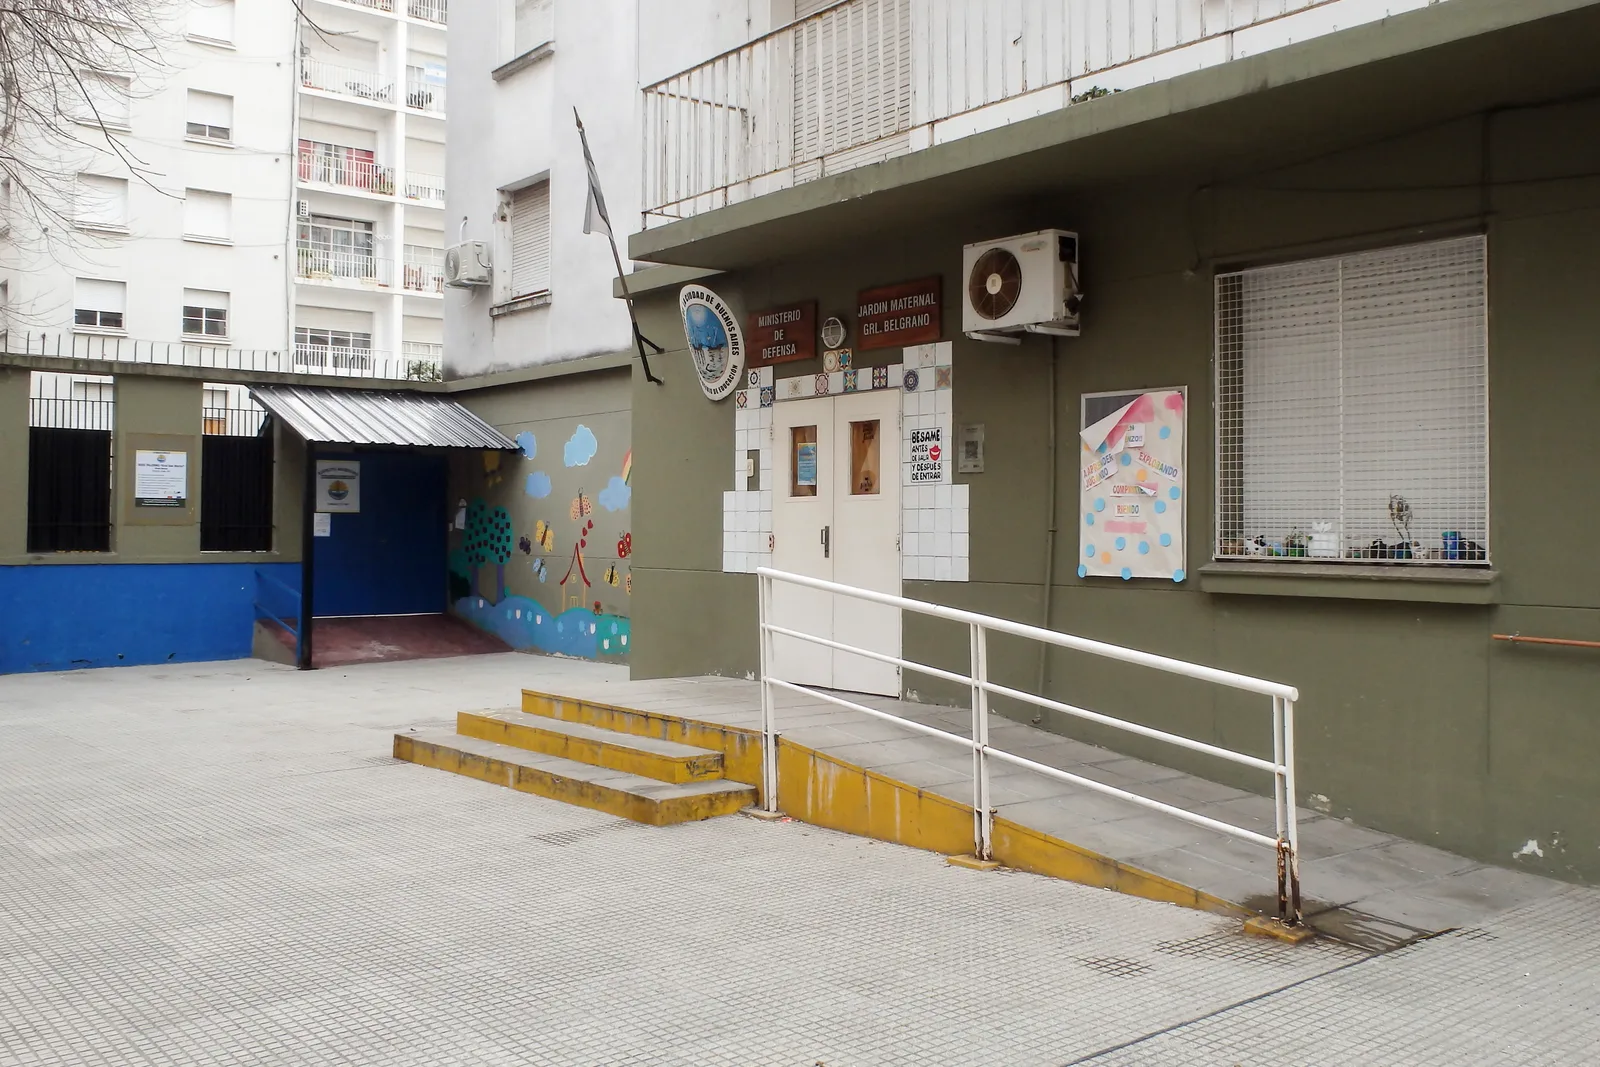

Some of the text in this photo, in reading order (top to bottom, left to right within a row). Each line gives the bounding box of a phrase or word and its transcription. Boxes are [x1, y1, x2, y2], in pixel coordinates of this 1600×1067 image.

[857, 293, 936, 318] JARDIN MATERNAL
[684, 290, 705, 302] CIUDAD
[705, 293, 715, 305] DE
[714, 302, 736, 333] BUENOS
[729, 333, 740, 356] AIRES
[758, 309, 801, 328] MINISTERIO
[863, 313, 930, 336] GRL. BELGRANO
[774, 329, 784, 341] DE
[762, 343, 796, 360] DEFENSA
[911, 444, 928, 453] ANTES
[912, 454, 917, 462] DE
[1087, 453, 1114, 476] APRENDER
[1138, 451, 1178, 478] EXPLORANDO
[911, 471, 941, 480] DE ENTRAR
[912, 463, 916, 471] Y
[1116, 504, 1140, 514] RIENDO
